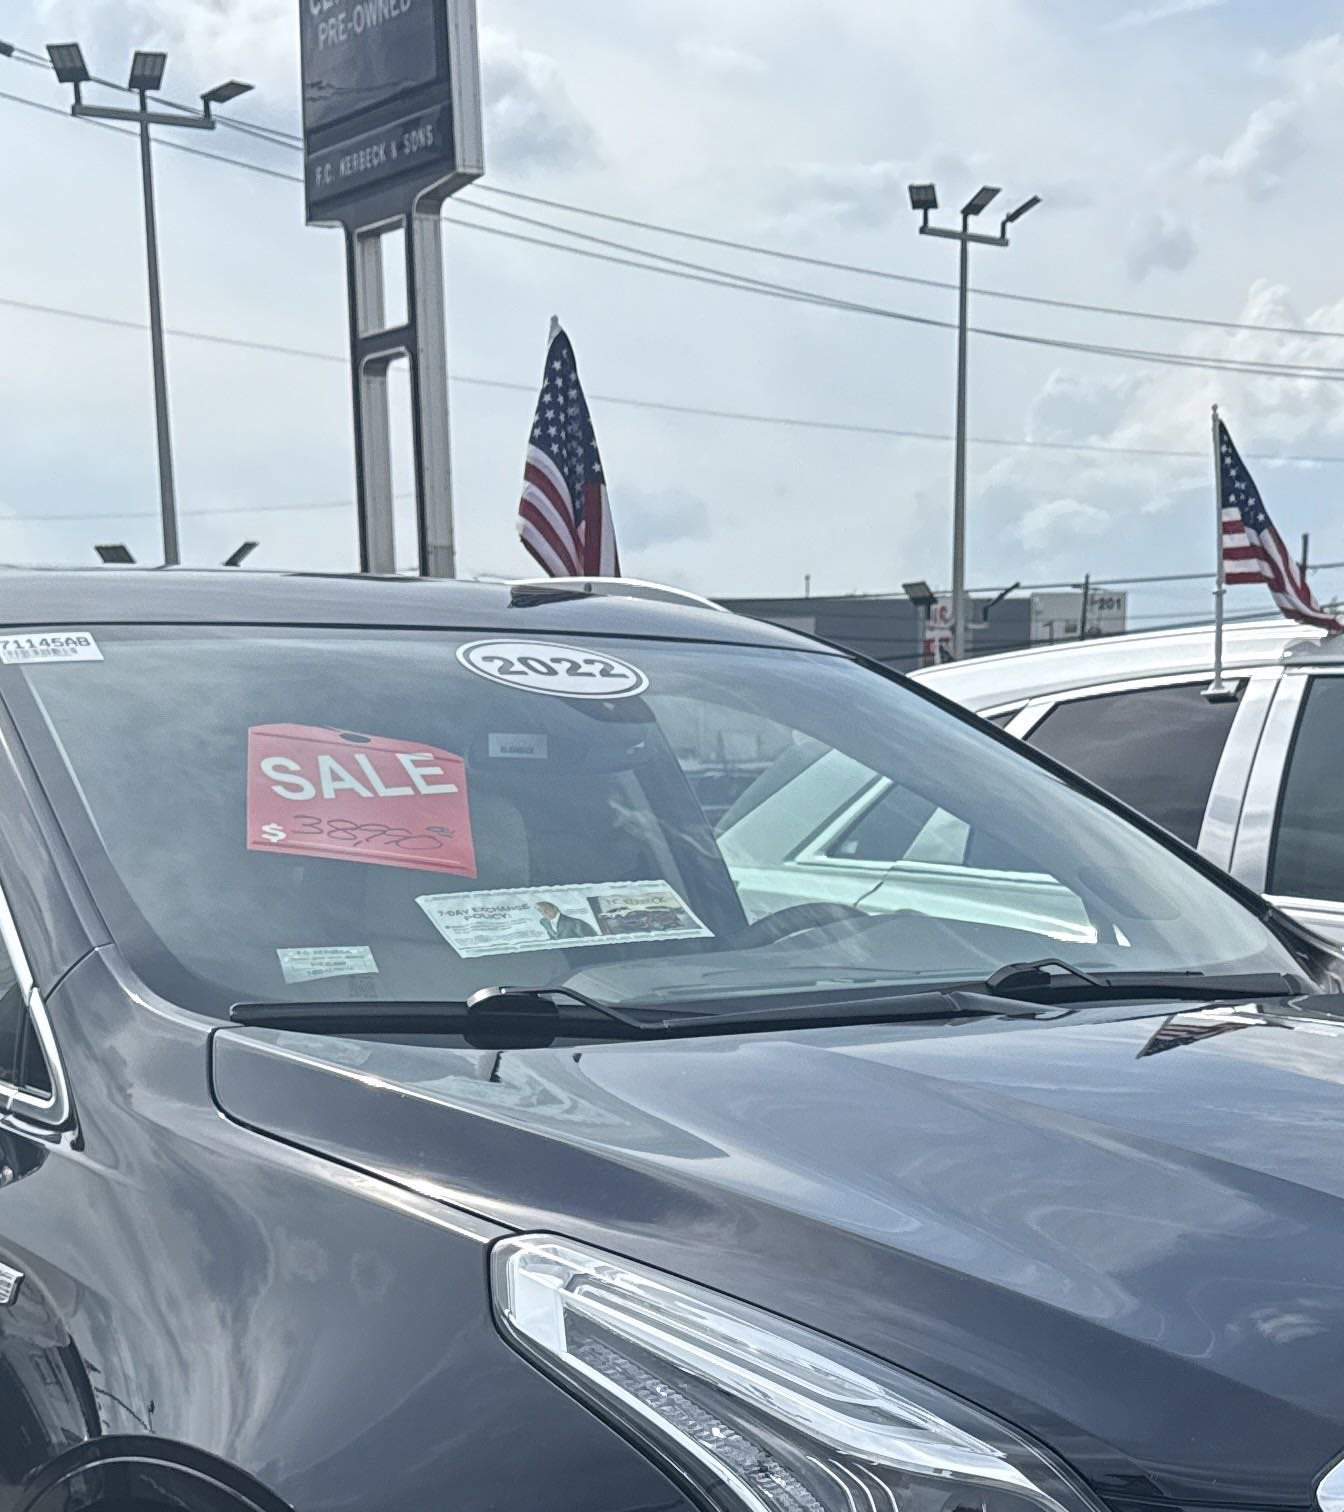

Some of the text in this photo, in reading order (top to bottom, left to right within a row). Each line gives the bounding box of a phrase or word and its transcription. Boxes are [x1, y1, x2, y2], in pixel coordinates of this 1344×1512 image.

[339, 143, 386, 177] KERBECK
[404, 125, 434, 155] SONS
[481, 655, 630, 679] 2022
[260, 752, 459, 801] SALE
[261, 822, 287, 843] $
